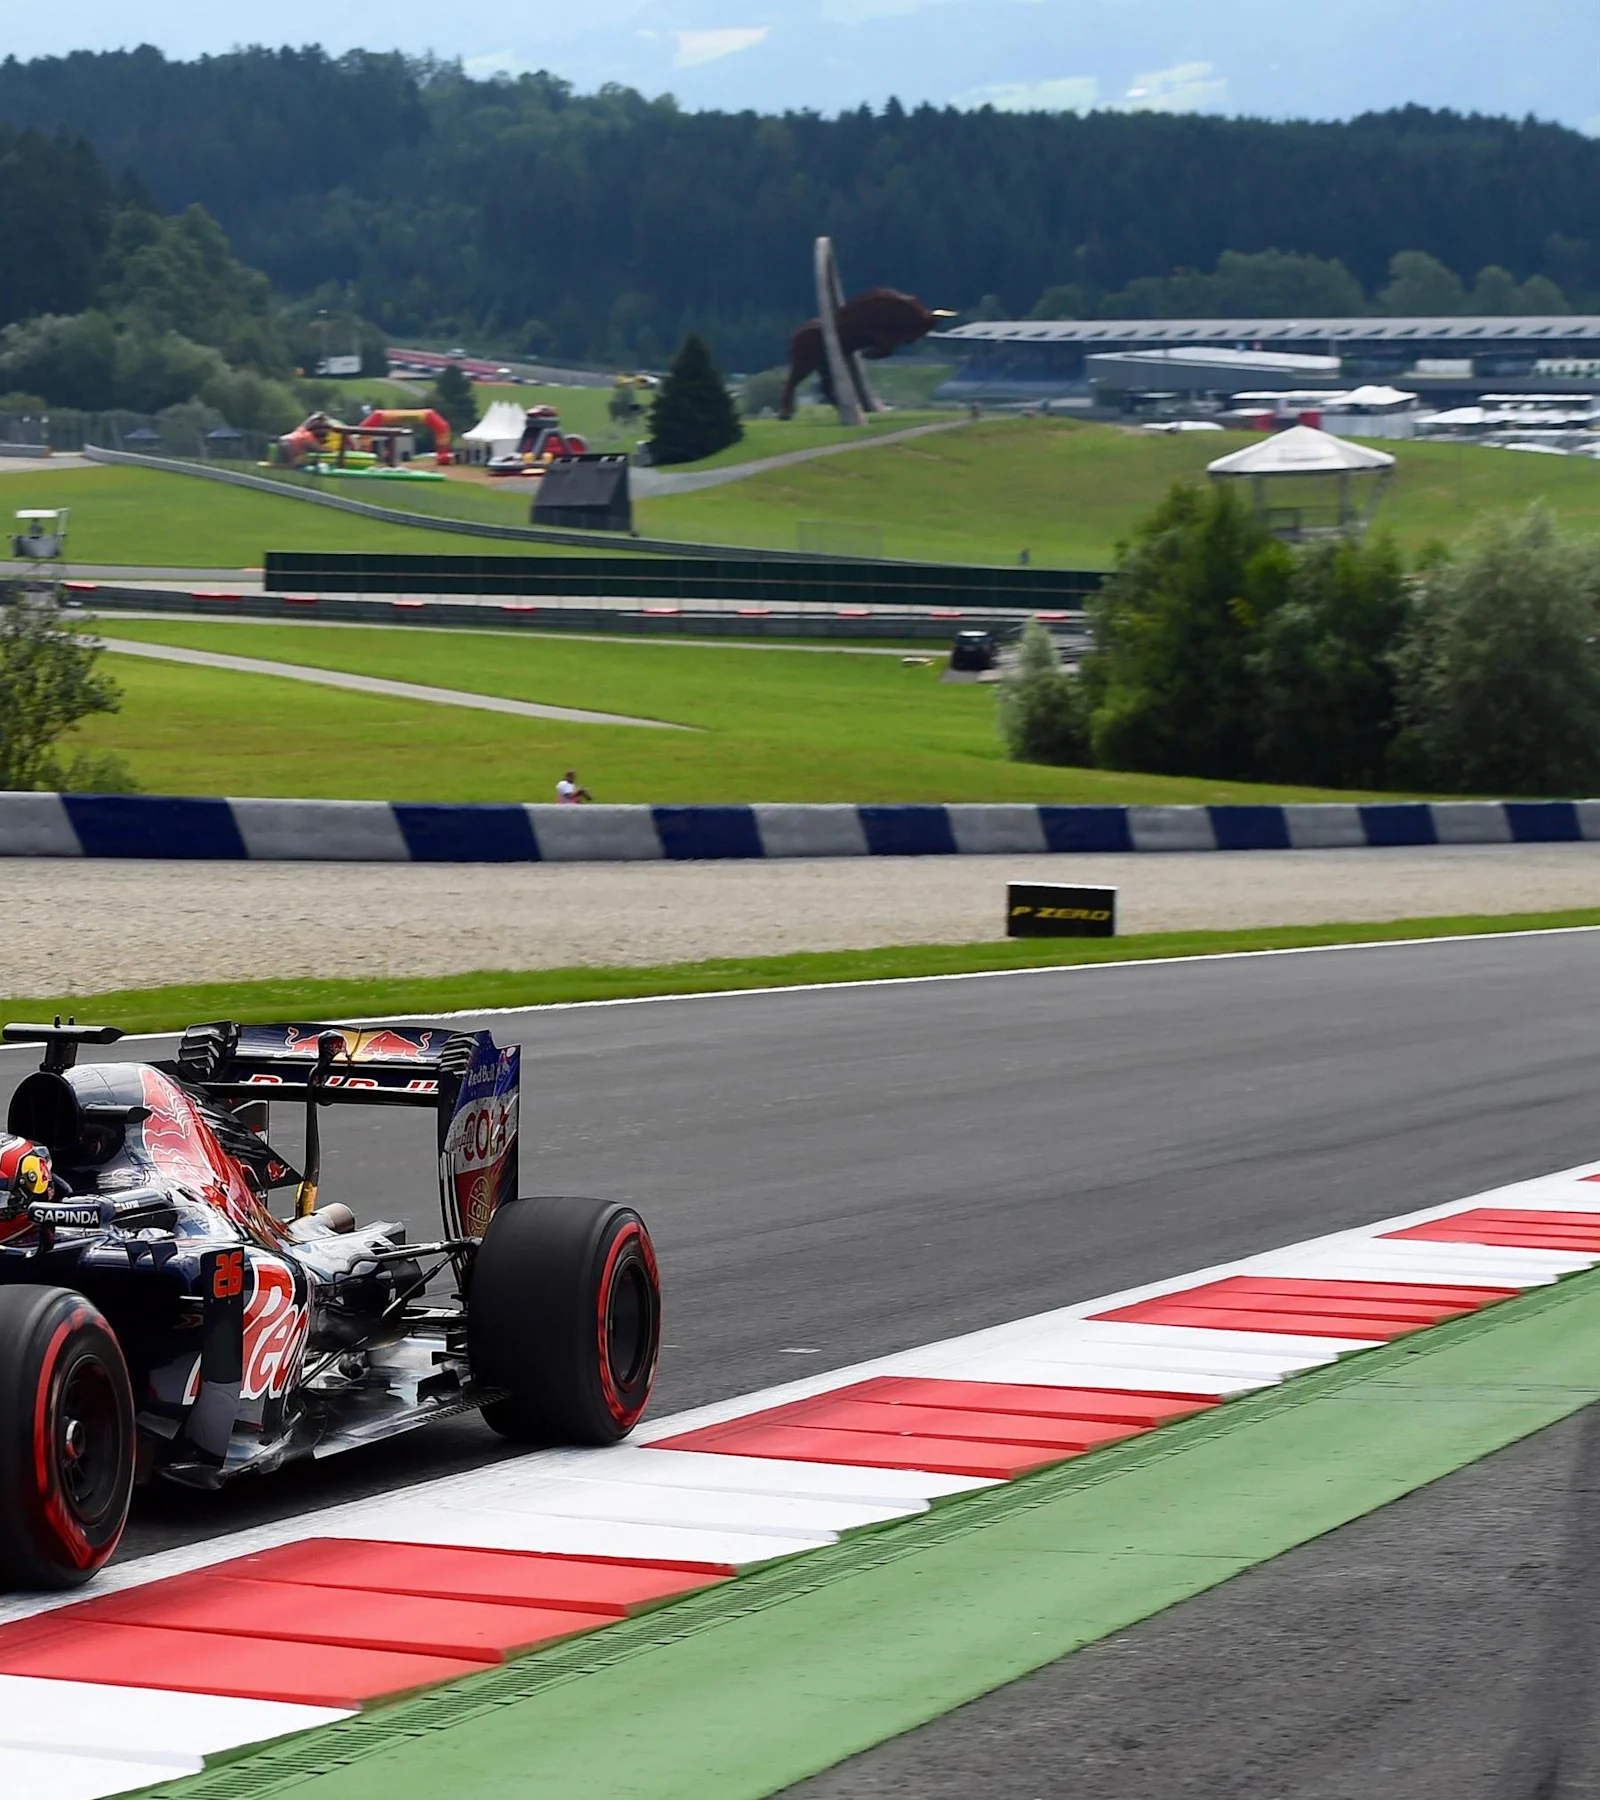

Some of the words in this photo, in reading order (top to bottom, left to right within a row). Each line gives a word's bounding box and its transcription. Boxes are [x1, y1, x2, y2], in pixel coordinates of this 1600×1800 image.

[1011, 906, 1032, 916] P
[1035, 907, 1111, 921] ZERO
[34, 1209, 99, 1225] SAPINDA
[213, 1251, 243, 1298] 26
